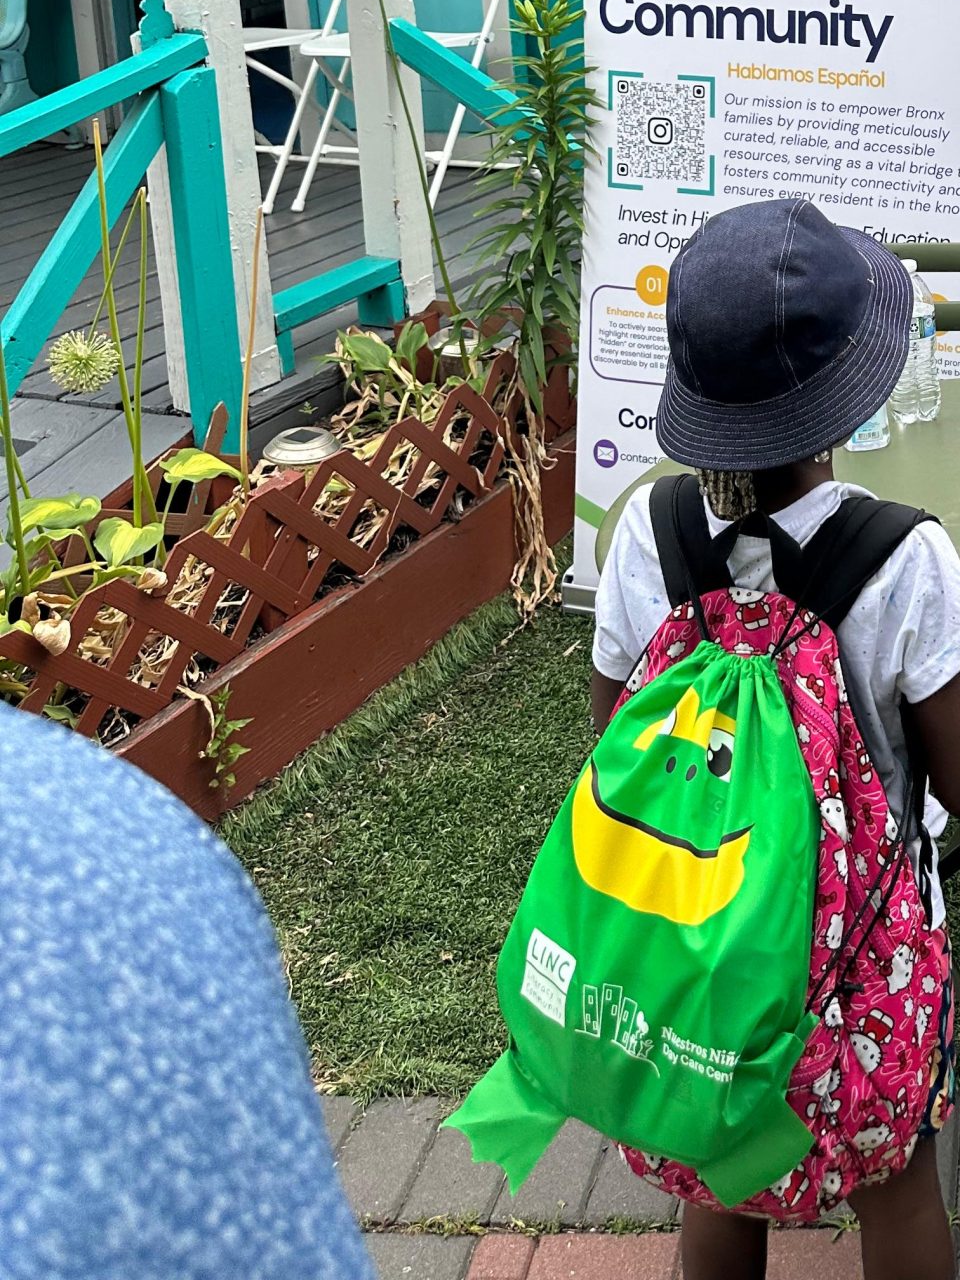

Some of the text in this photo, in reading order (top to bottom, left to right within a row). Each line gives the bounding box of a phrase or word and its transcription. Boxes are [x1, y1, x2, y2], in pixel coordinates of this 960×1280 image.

[727, 62, 886, 89] Hablamos Español
[724, 92, 946, 121] Our mission is to empower Bronx
[723, 111, 951, 143] families by providing meticulously
[723, 130, 936, 158] curated, reliable, and accessible
[723, 147, 792, 166] resources,
[794, 153, 843, 170] serving
[845, 159, 862, 170] as
[865, 161, 874, 171] a
[877, 159, 906, 173] vital
[908, 161, 954, 180] bridge
[723, 164, 770, 180] fosters
[772, 169, 848, 189] community
[850, 175, 935, 196] connectivity
[723, 184, 775, 199] ensures
[778, 190, 816, 202] every
[818, 191, 874, 208] resident
[877, 195, 889, 209] is
[892, 196, 905, 210] in
[908, 198, 932, 213] the
[618, 204, 668, 225] Invest
[672, 208, 687, 226] in
[618, 231, 650, 247] and
[645, 276, 662, 293] 01
[606, 306, 646, 318] Enhance
[598, 327, 665, 342] highlight resources
[609, 320, 618, 328] To
[618, 322, 646, 332] actively
[593, 355, 638, 367] discoverable
[638, 359, 648, 370] by
[600, 347, 619, 357] every
[620, 349, 652, 359] essential
[940, 368, 953, 376] we
[531, 937, 570, 983] LINC
[661, 1025, 708, 1059] Nuestros
[662, 1041, 679, 1065] Day
[680, 1053, 705, 1075] Care
